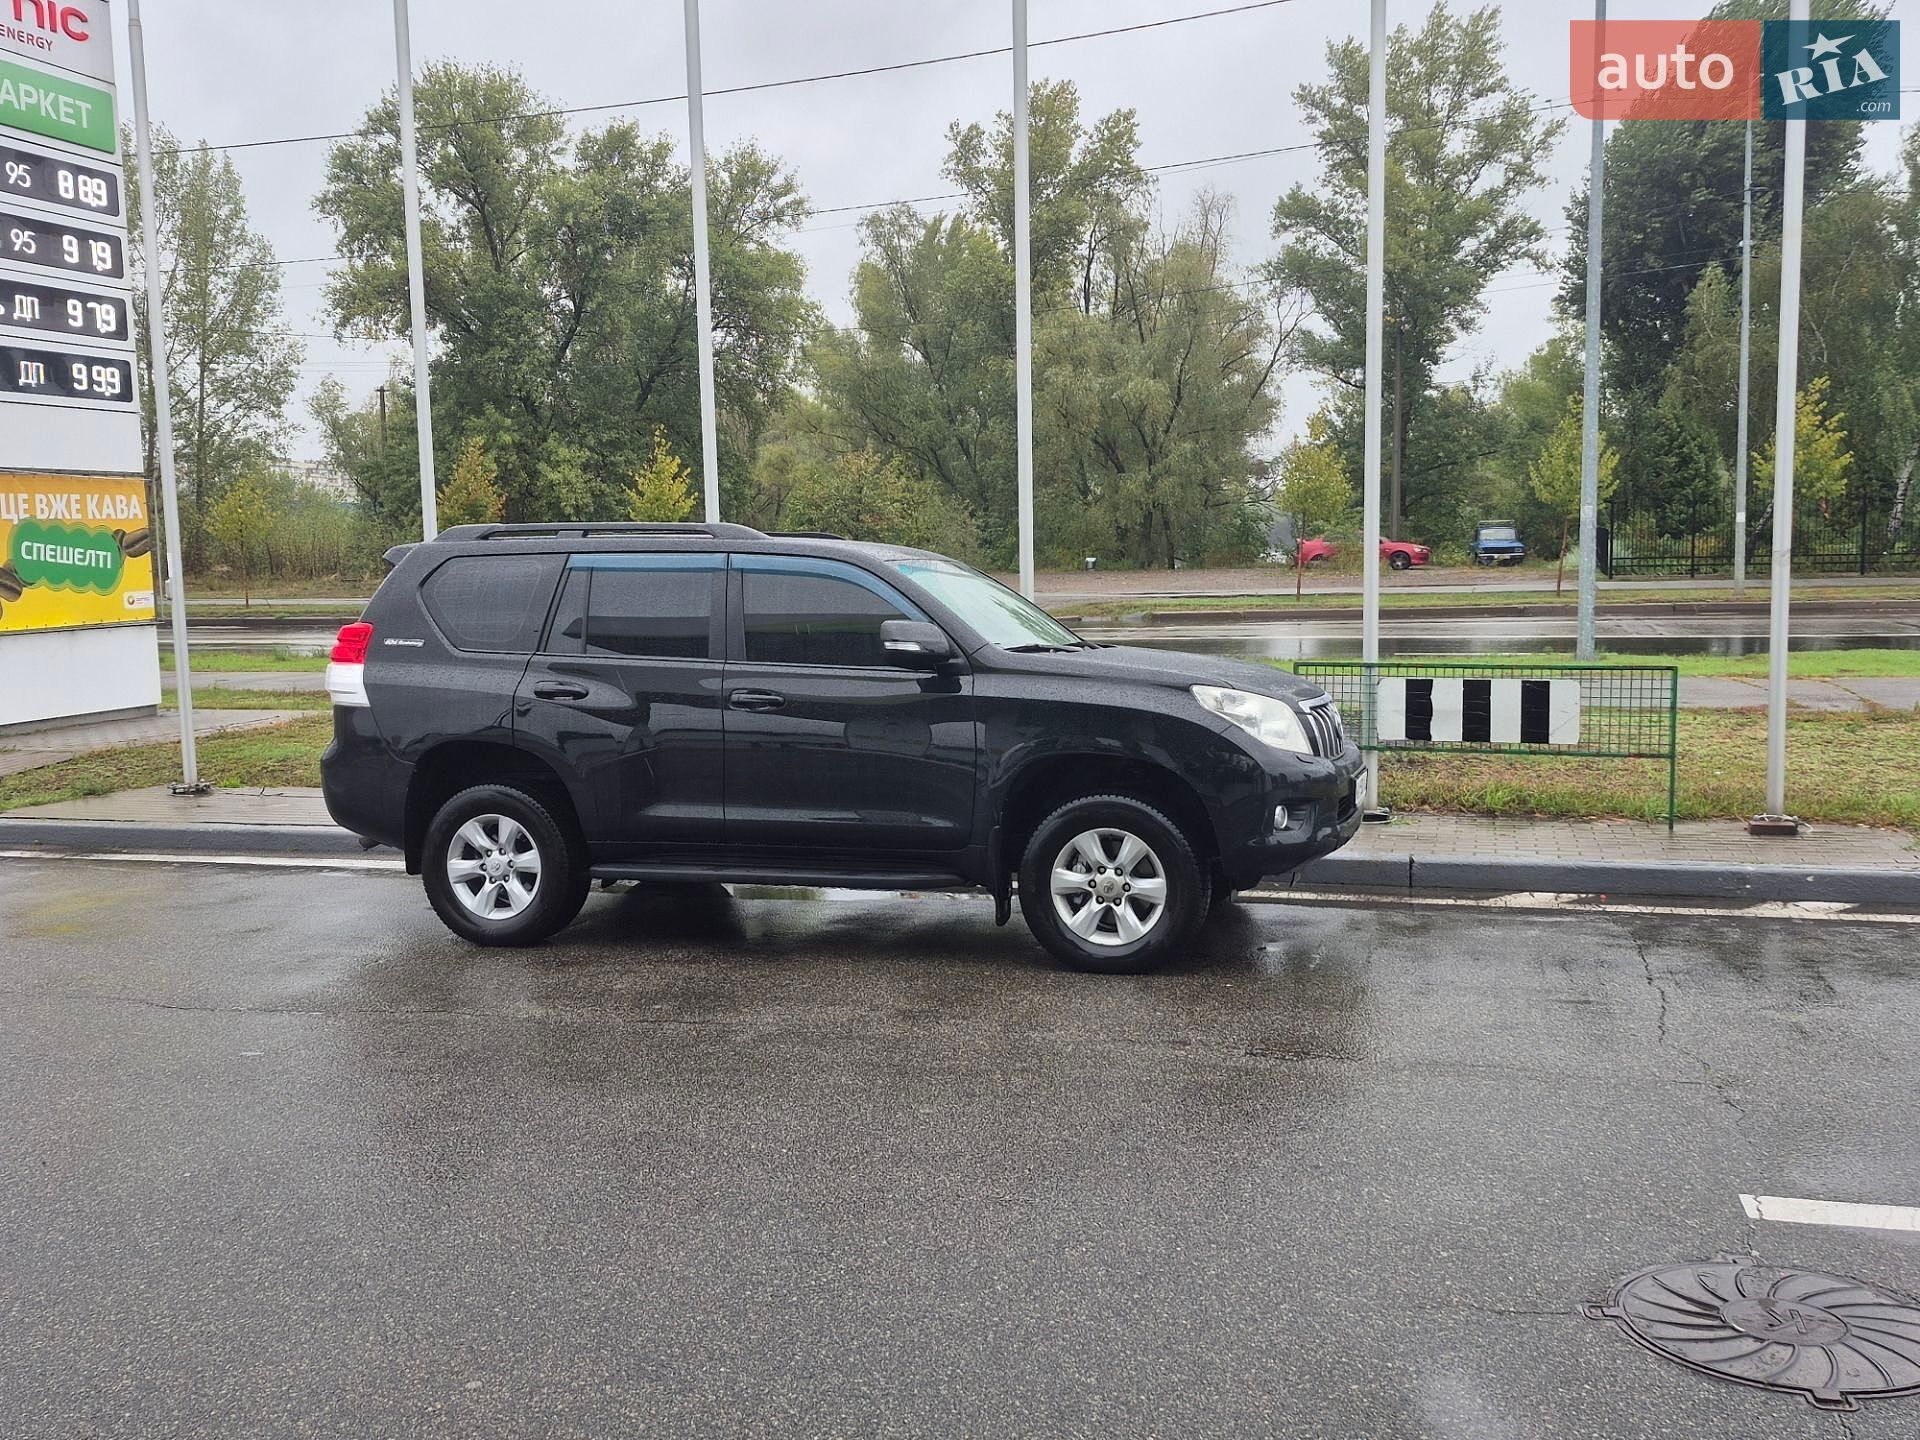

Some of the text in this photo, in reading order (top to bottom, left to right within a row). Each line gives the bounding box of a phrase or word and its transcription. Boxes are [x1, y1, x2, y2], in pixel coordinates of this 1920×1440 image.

[5, 161, 32, 188] 95
[10, 228, 37, 254] 95
[13, 294, 40, 322] ДП
[18, 360, 46, 388] ДП
[0, 493, 144, 525] ЦЕ ВЖЕ КАВА
[21, 541, 112, 569] СПЕШЕЛТІ
